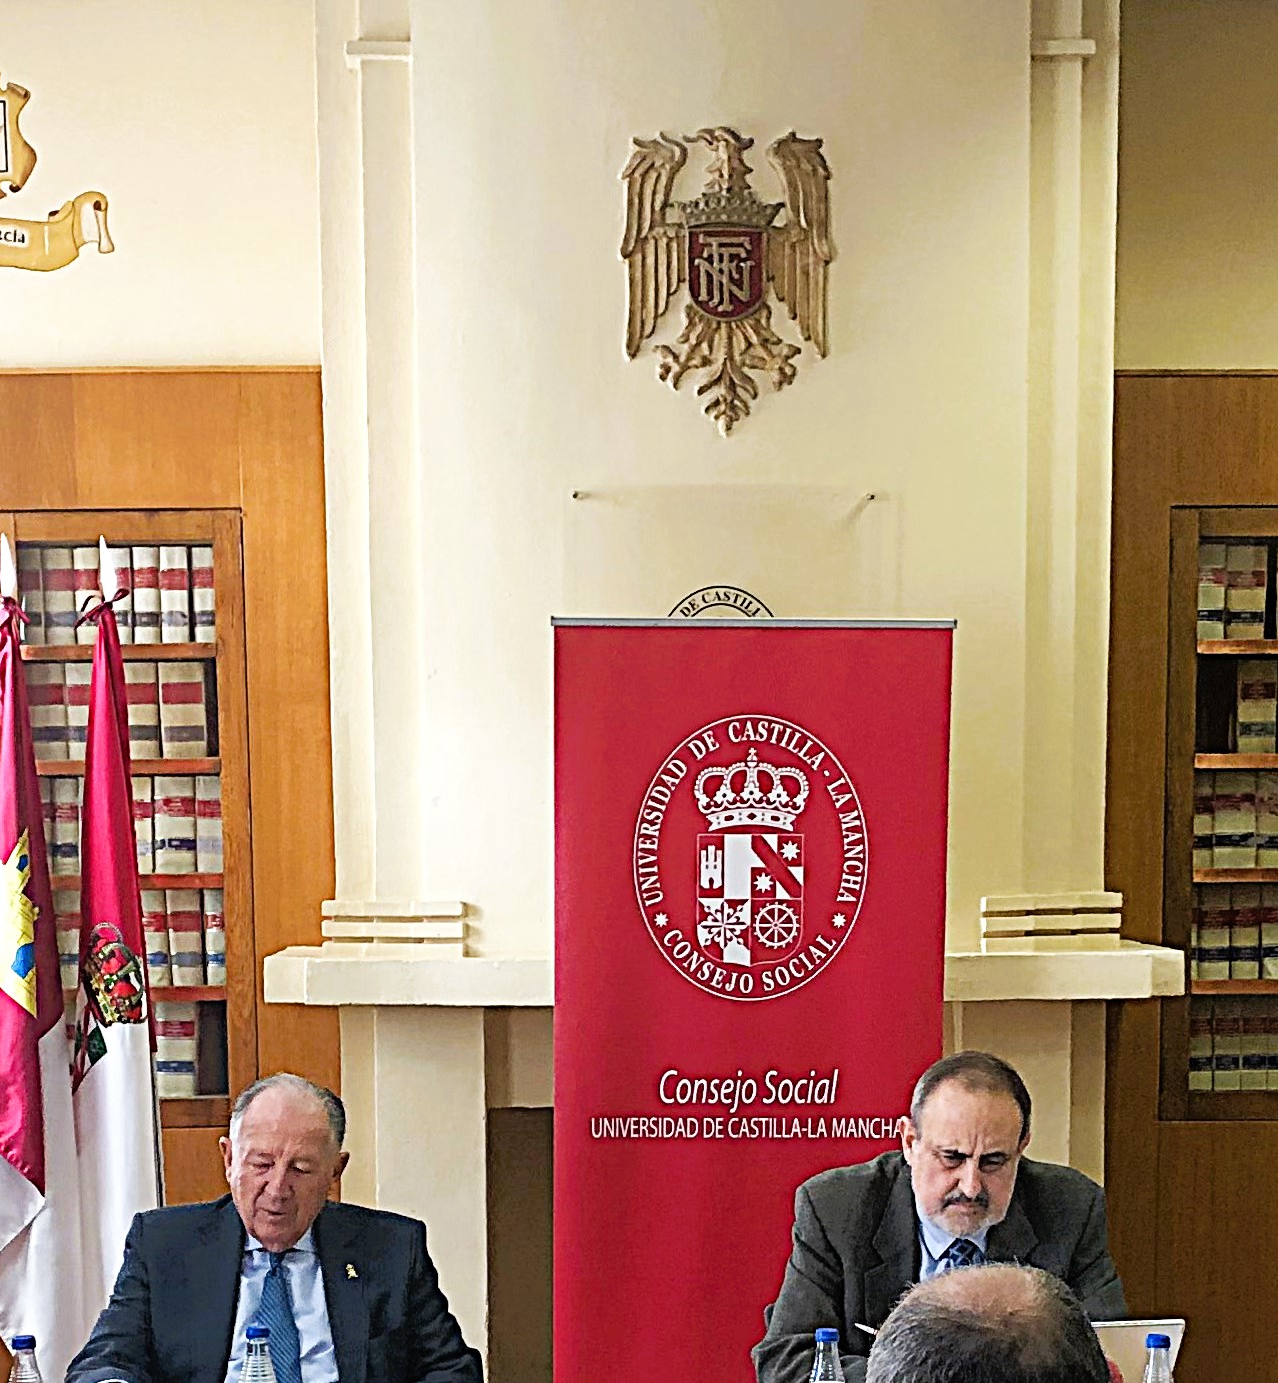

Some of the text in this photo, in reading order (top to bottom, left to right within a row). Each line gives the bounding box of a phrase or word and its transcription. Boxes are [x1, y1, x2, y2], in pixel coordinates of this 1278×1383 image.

[679, 598, 700, 617] DE
[687, 730, 720, 761] DE
[727, 720, 826, 771] CASTILLA
[826, 776, 853, 809] LA
[638, 758, 688, 907] UNIVERSIDAD
[836, 809, 864, 902] MANCHA
[663, 929, 838, 994] CONSEJO SOCIAL
[659, 1068, 839, 1114] Consejo Social
[590, 1116, 903, 1139] UNIVERSIDAD DE CASTILLA-LA MANCHA
